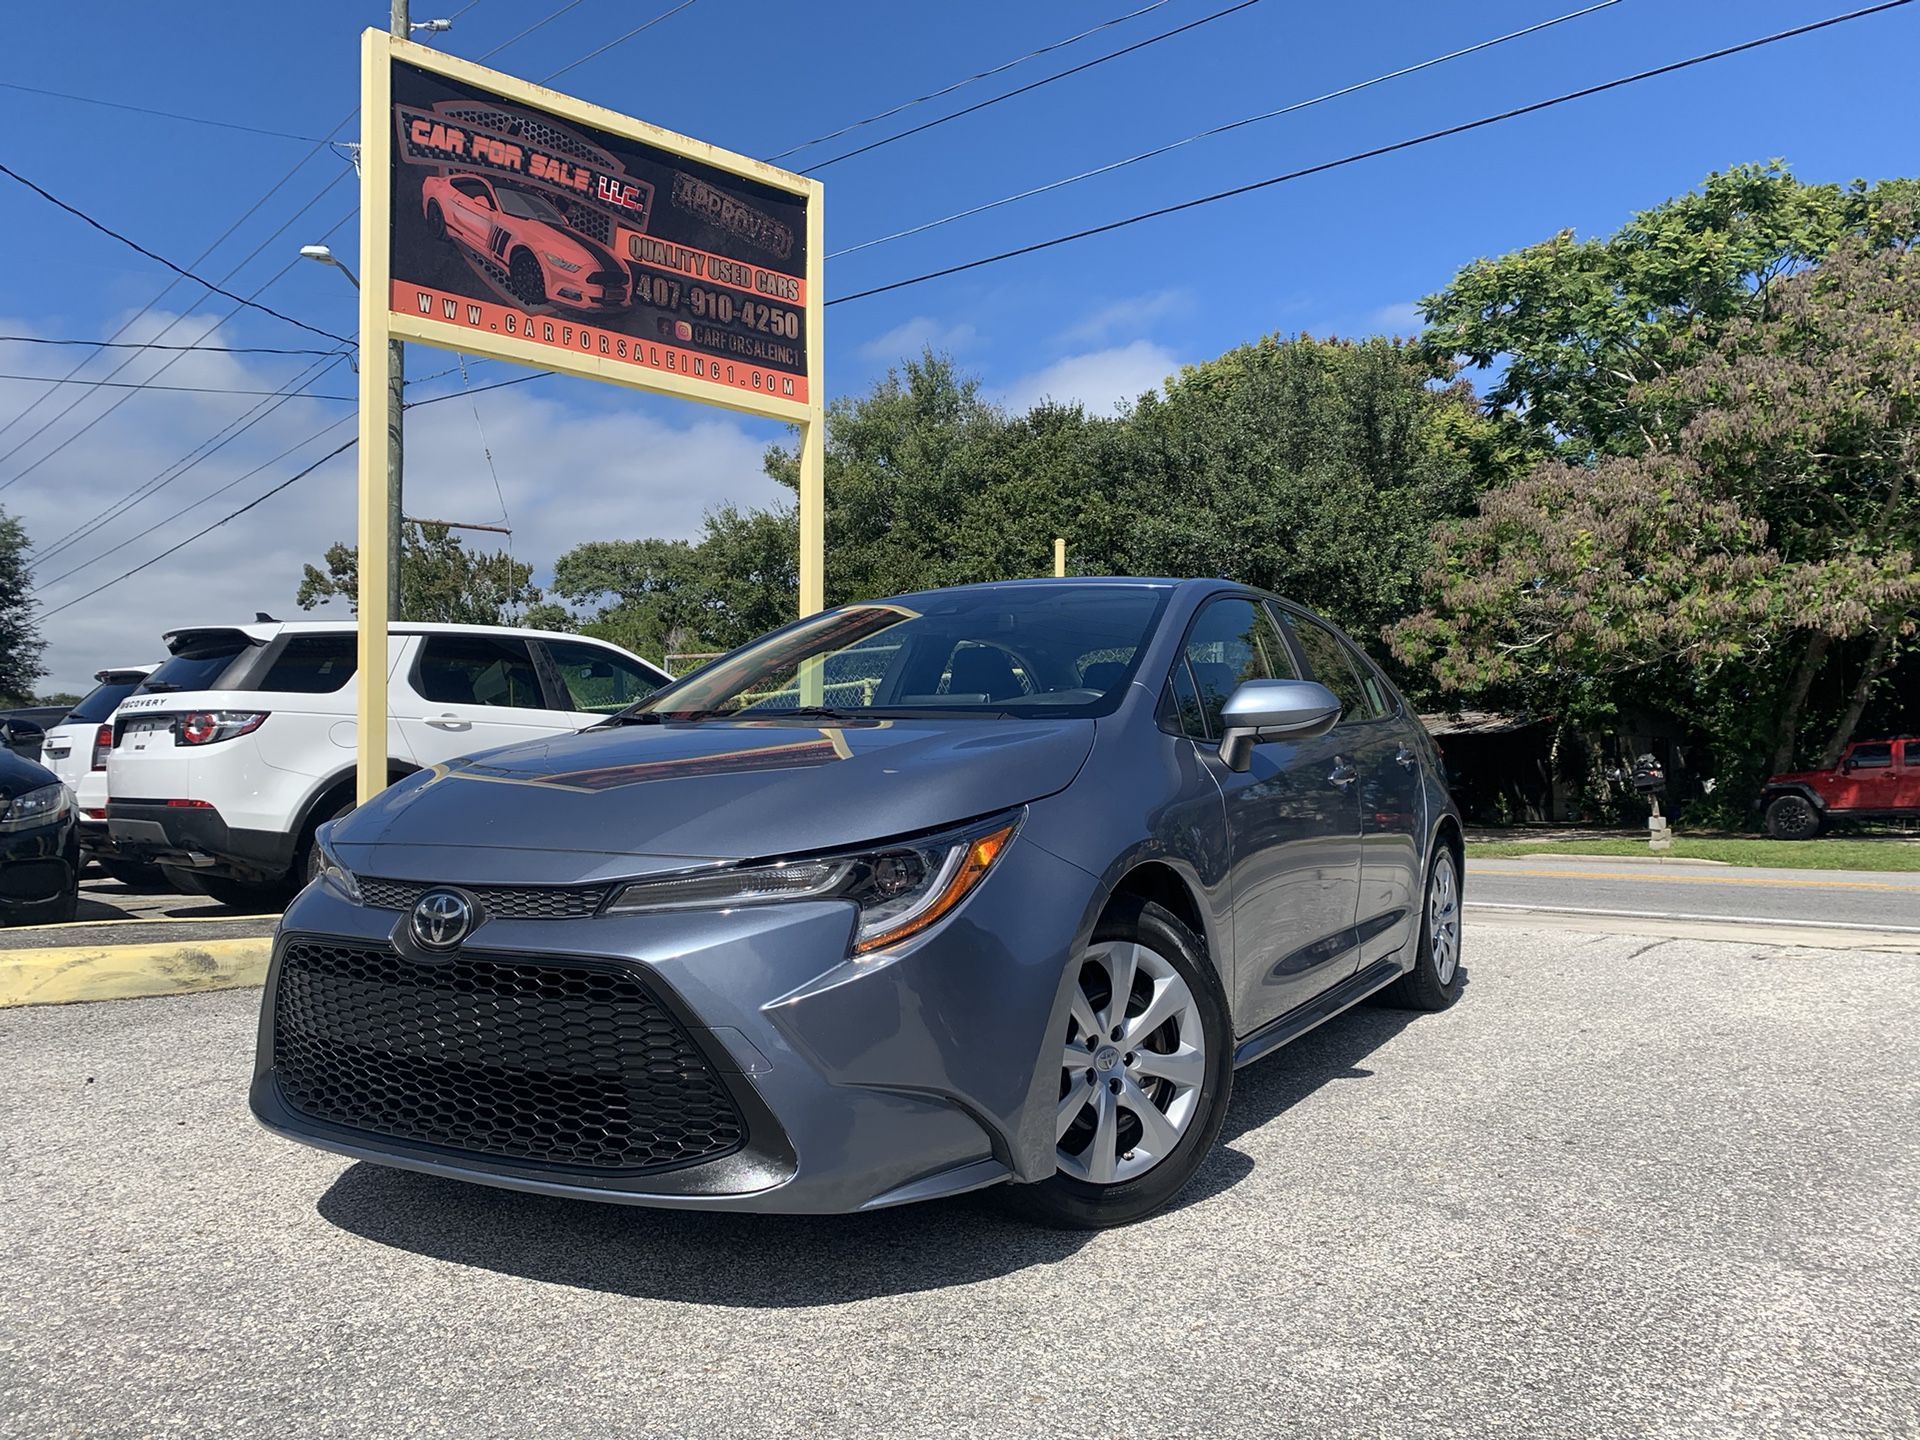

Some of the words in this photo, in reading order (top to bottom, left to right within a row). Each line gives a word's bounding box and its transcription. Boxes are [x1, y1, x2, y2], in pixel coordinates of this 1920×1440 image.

[411, 119, 464, 154] CAR
[471, 135, 522, 170] FOR
[628, 234, 706, 276] QUALITY
[708, 256, 753, 289] USED
[755, 270, 799, 302] CARS
[636, 273, 800, 340] 407-910-4250
[416, 292, 795, 396] WWW.CARFORSALEINC1.COM
[694, 325, 800, 367] CARFORSALEINC1
